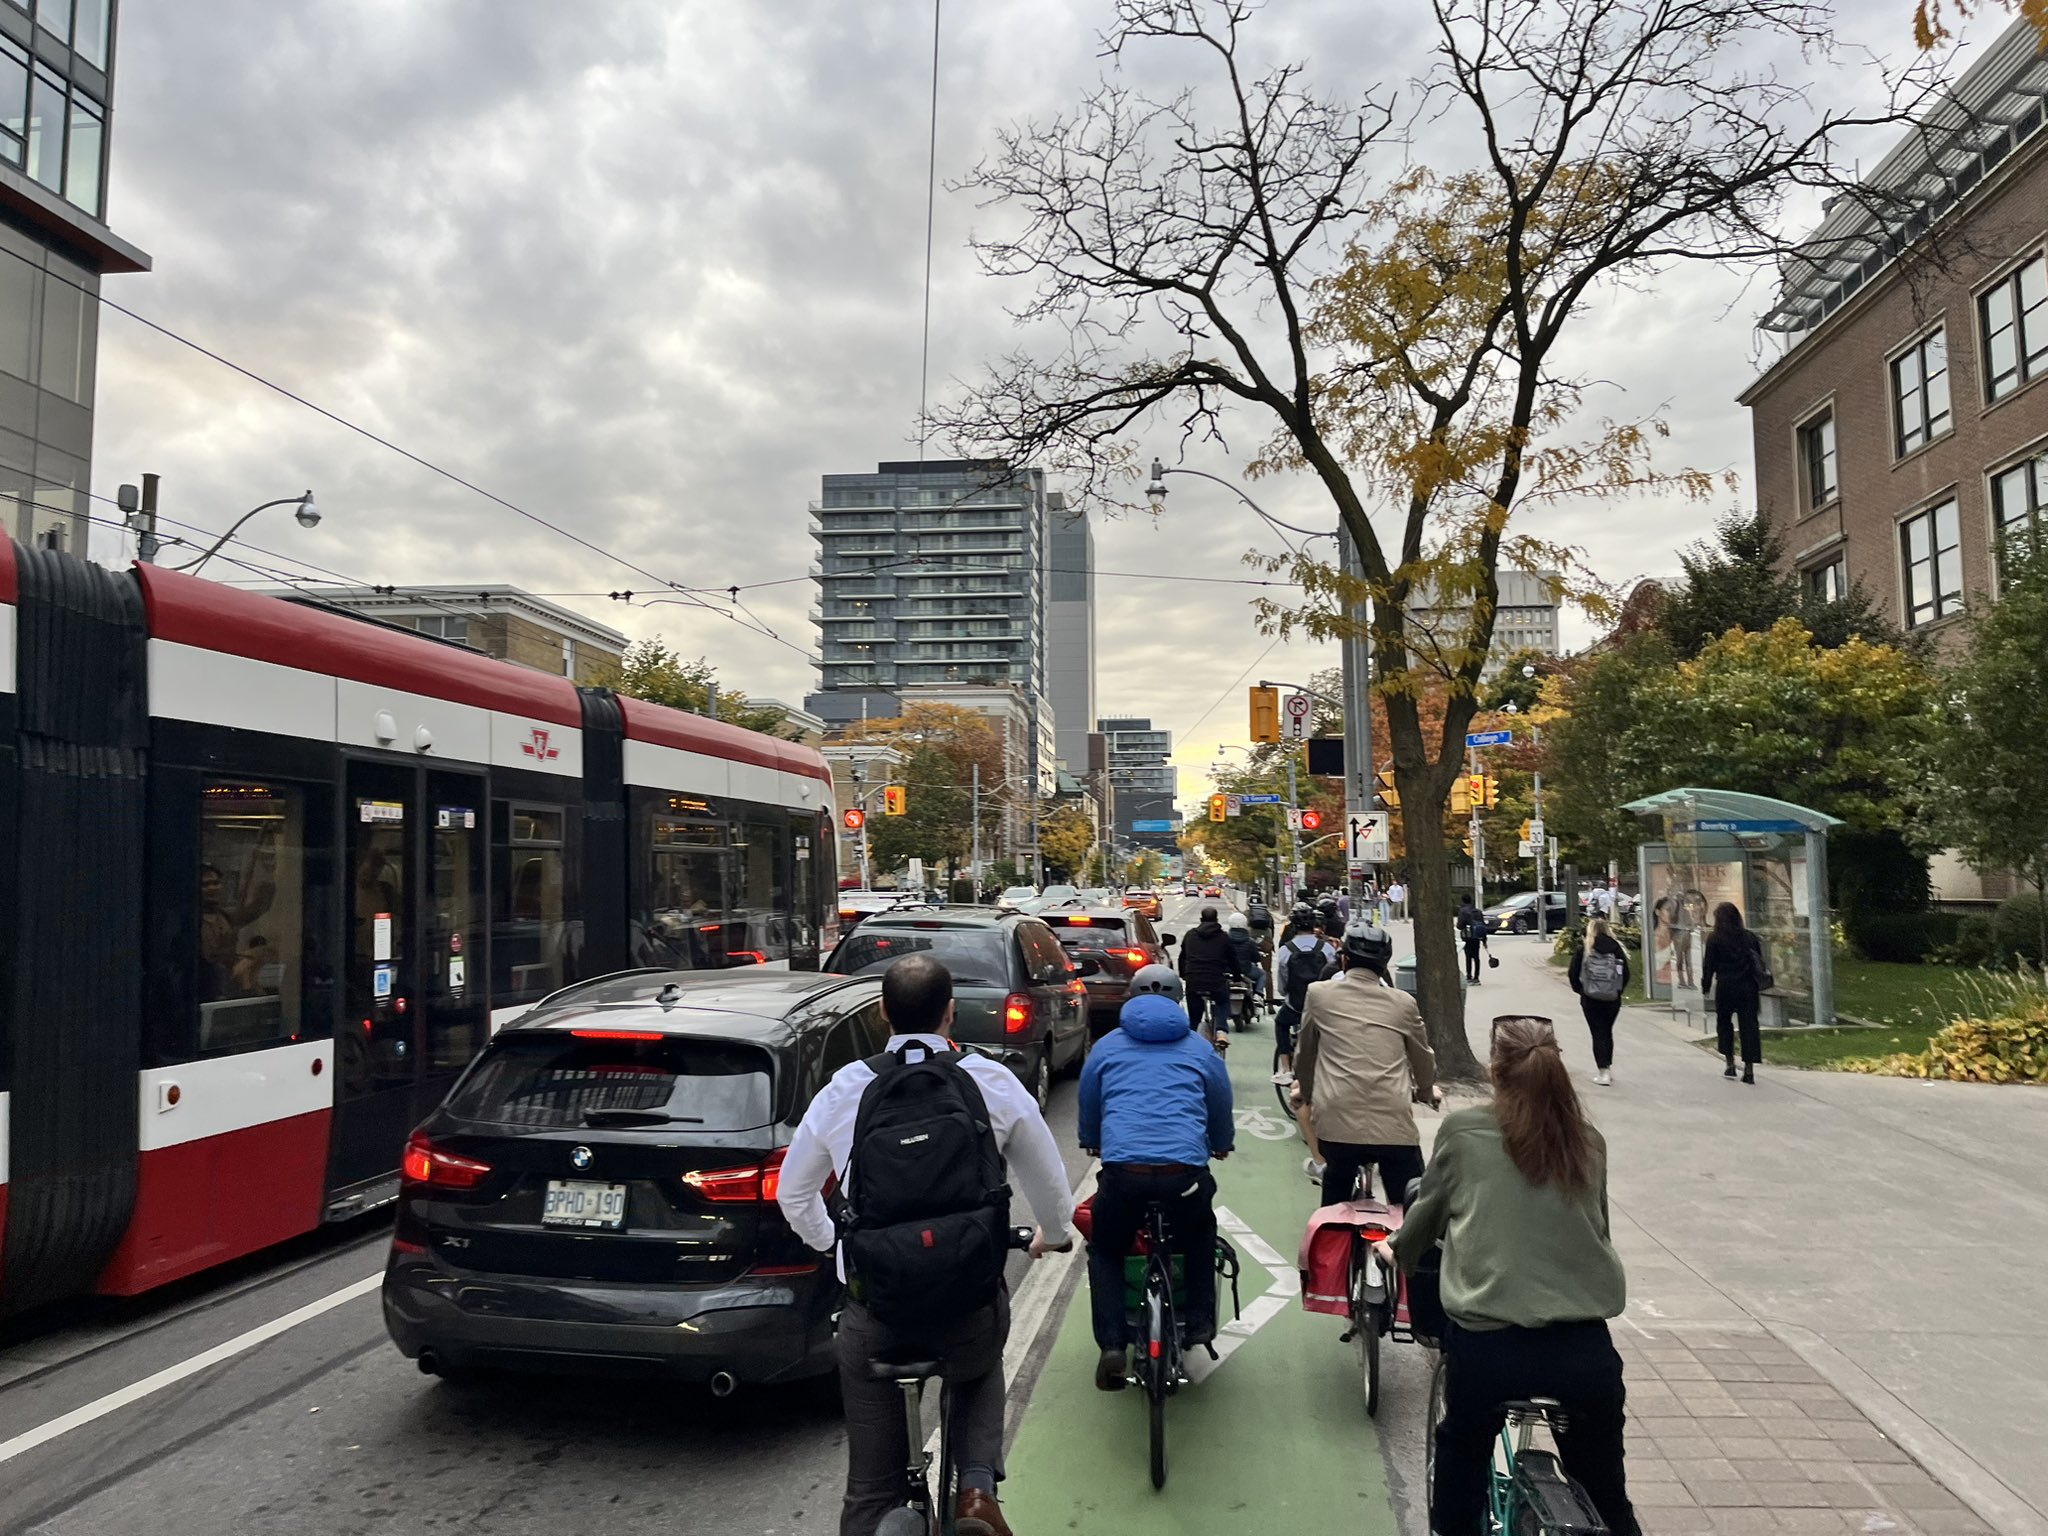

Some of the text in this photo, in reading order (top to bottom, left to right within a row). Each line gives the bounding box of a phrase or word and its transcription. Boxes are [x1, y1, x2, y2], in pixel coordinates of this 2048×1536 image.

[1473, 734, 1499, 745] College
[1531, 831, 1543, 844] 30
[595, 1192, 623, 1215] 190
